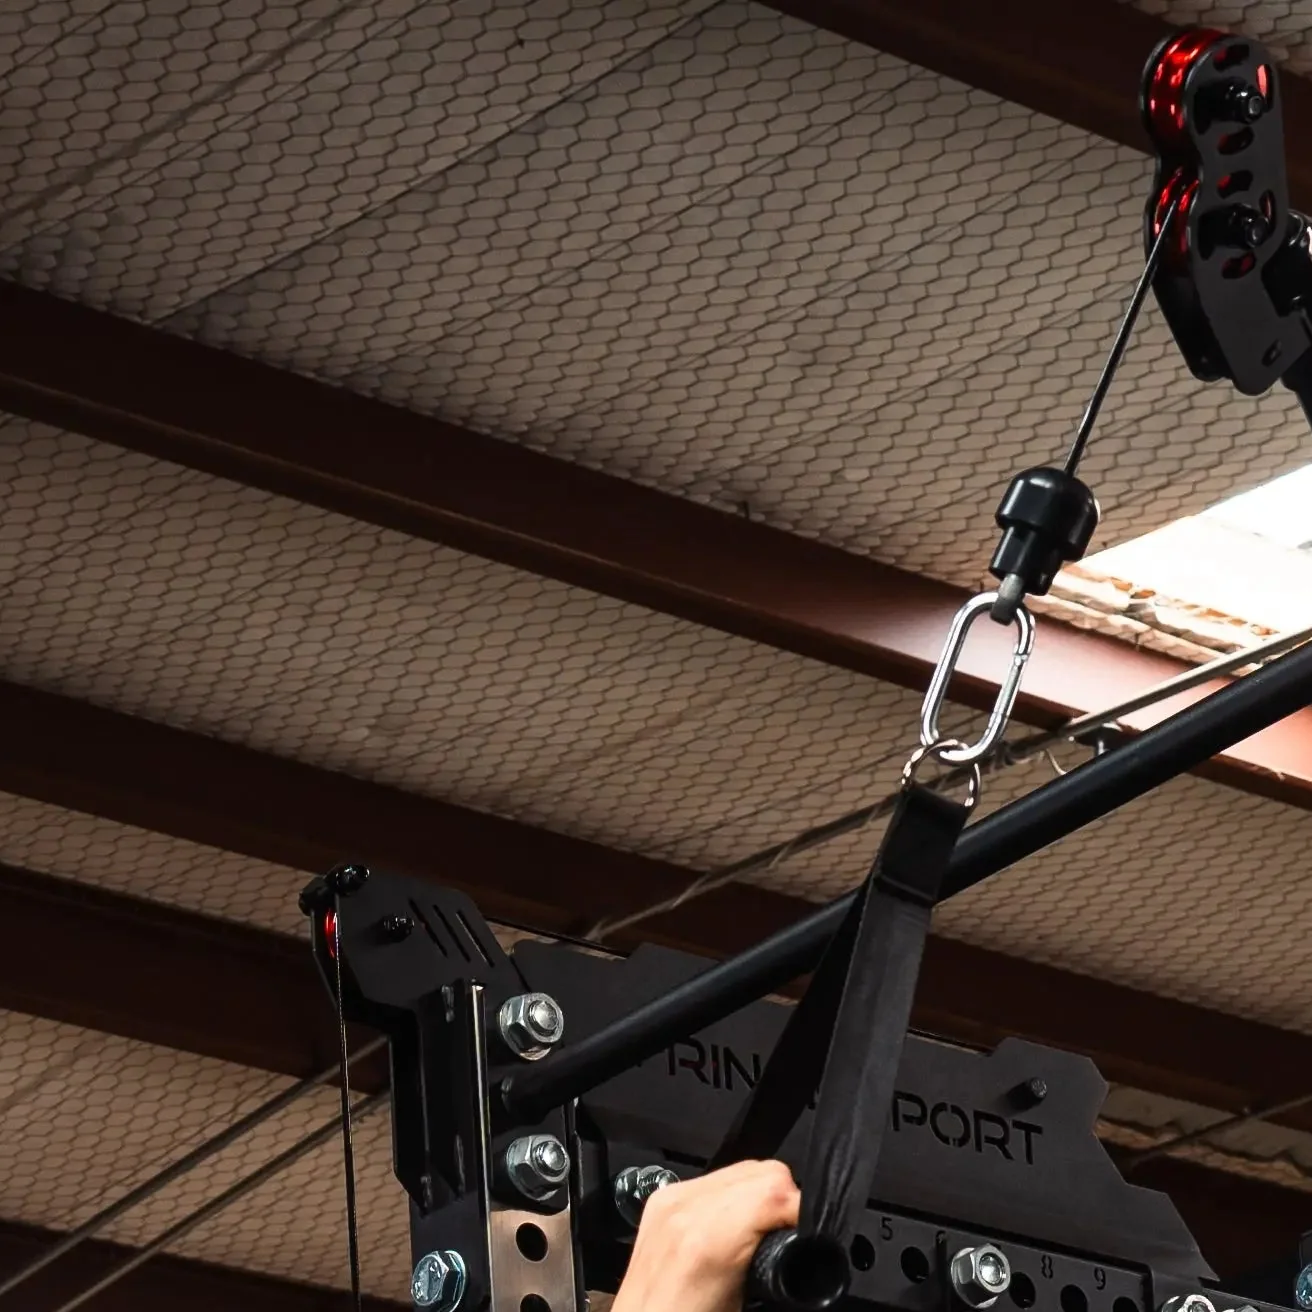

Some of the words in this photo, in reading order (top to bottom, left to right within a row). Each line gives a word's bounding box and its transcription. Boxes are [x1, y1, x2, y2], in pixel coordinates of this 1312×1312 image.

[891, 1090, 1044, 1167] PORT
[879, 1217, 894, 1242] 5
[1041, 1253, 1055, 1280] 8
[1093, 1267, 1107, 1292] 9
